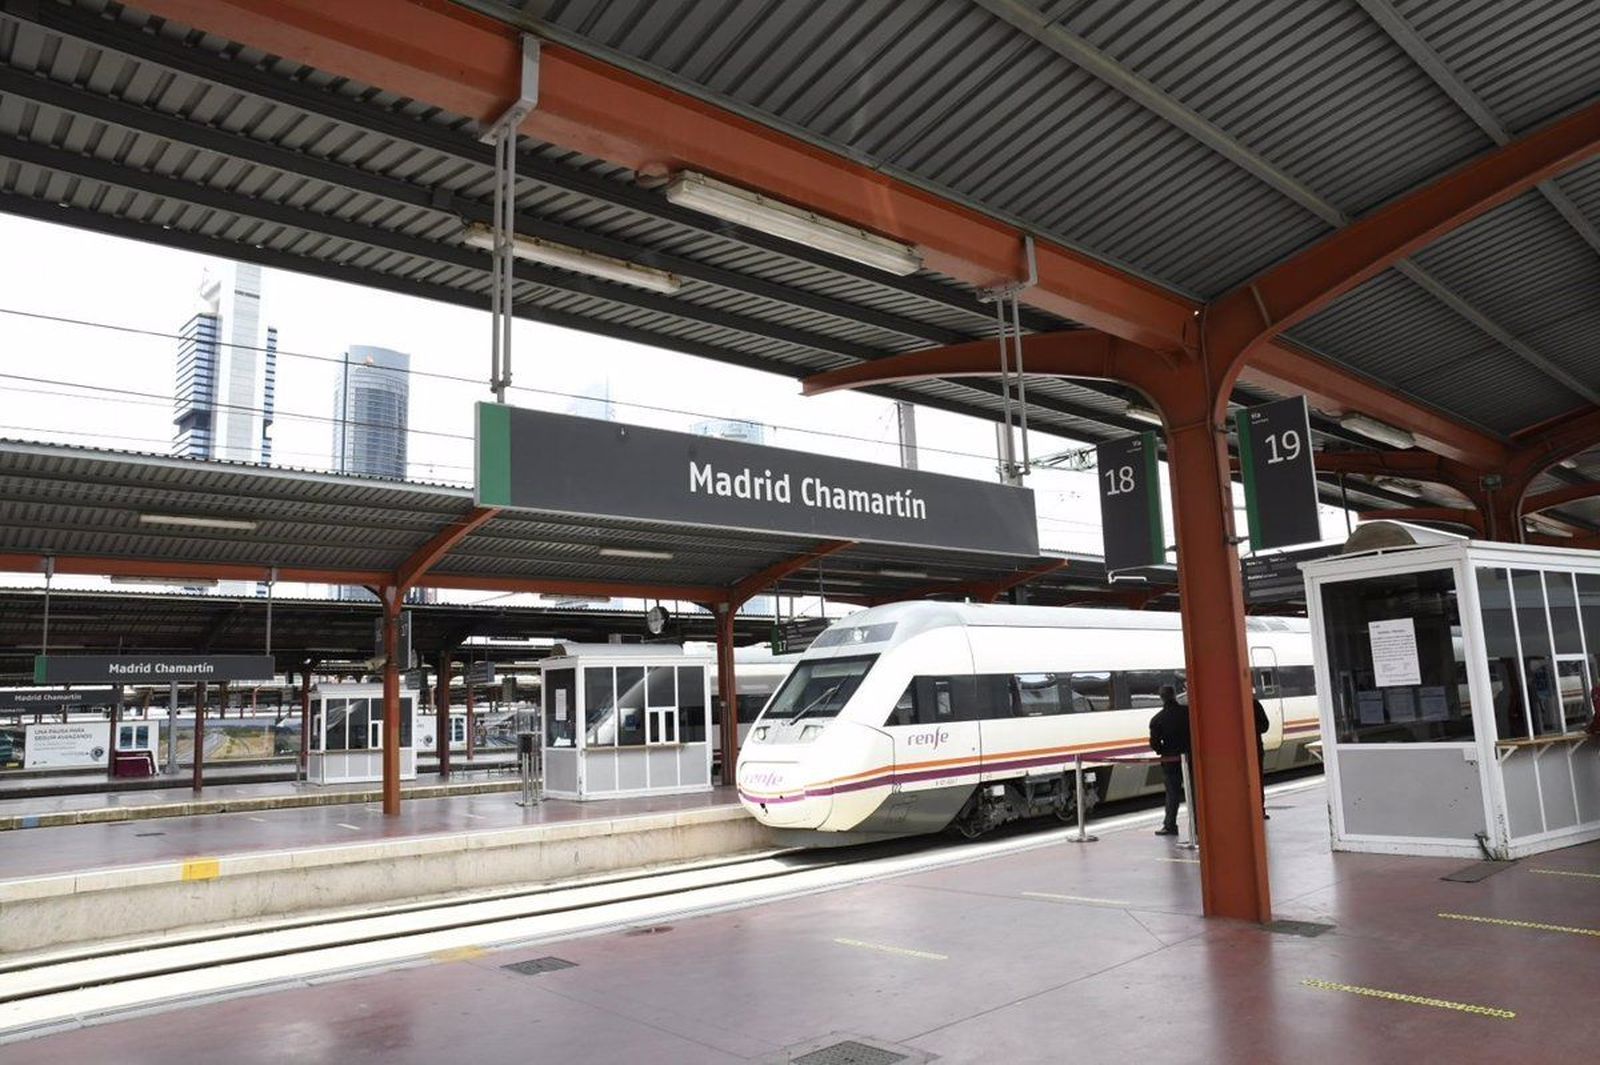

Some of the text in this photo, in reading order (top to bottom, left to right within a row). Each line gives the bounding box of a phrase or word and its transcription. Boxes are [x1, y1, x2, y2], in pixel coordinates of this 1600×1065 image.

[1264, 429, 1301, 465] 19
[689, 460, 927, 520] Madrid Chamartín
[1104, 465, 1136, 496] 18
[108, 662, 215, 674] Madrid Chamartín
[14, 692, 83, 702] Madrid Chamartín
[907, 726, 950, 751] renfe
